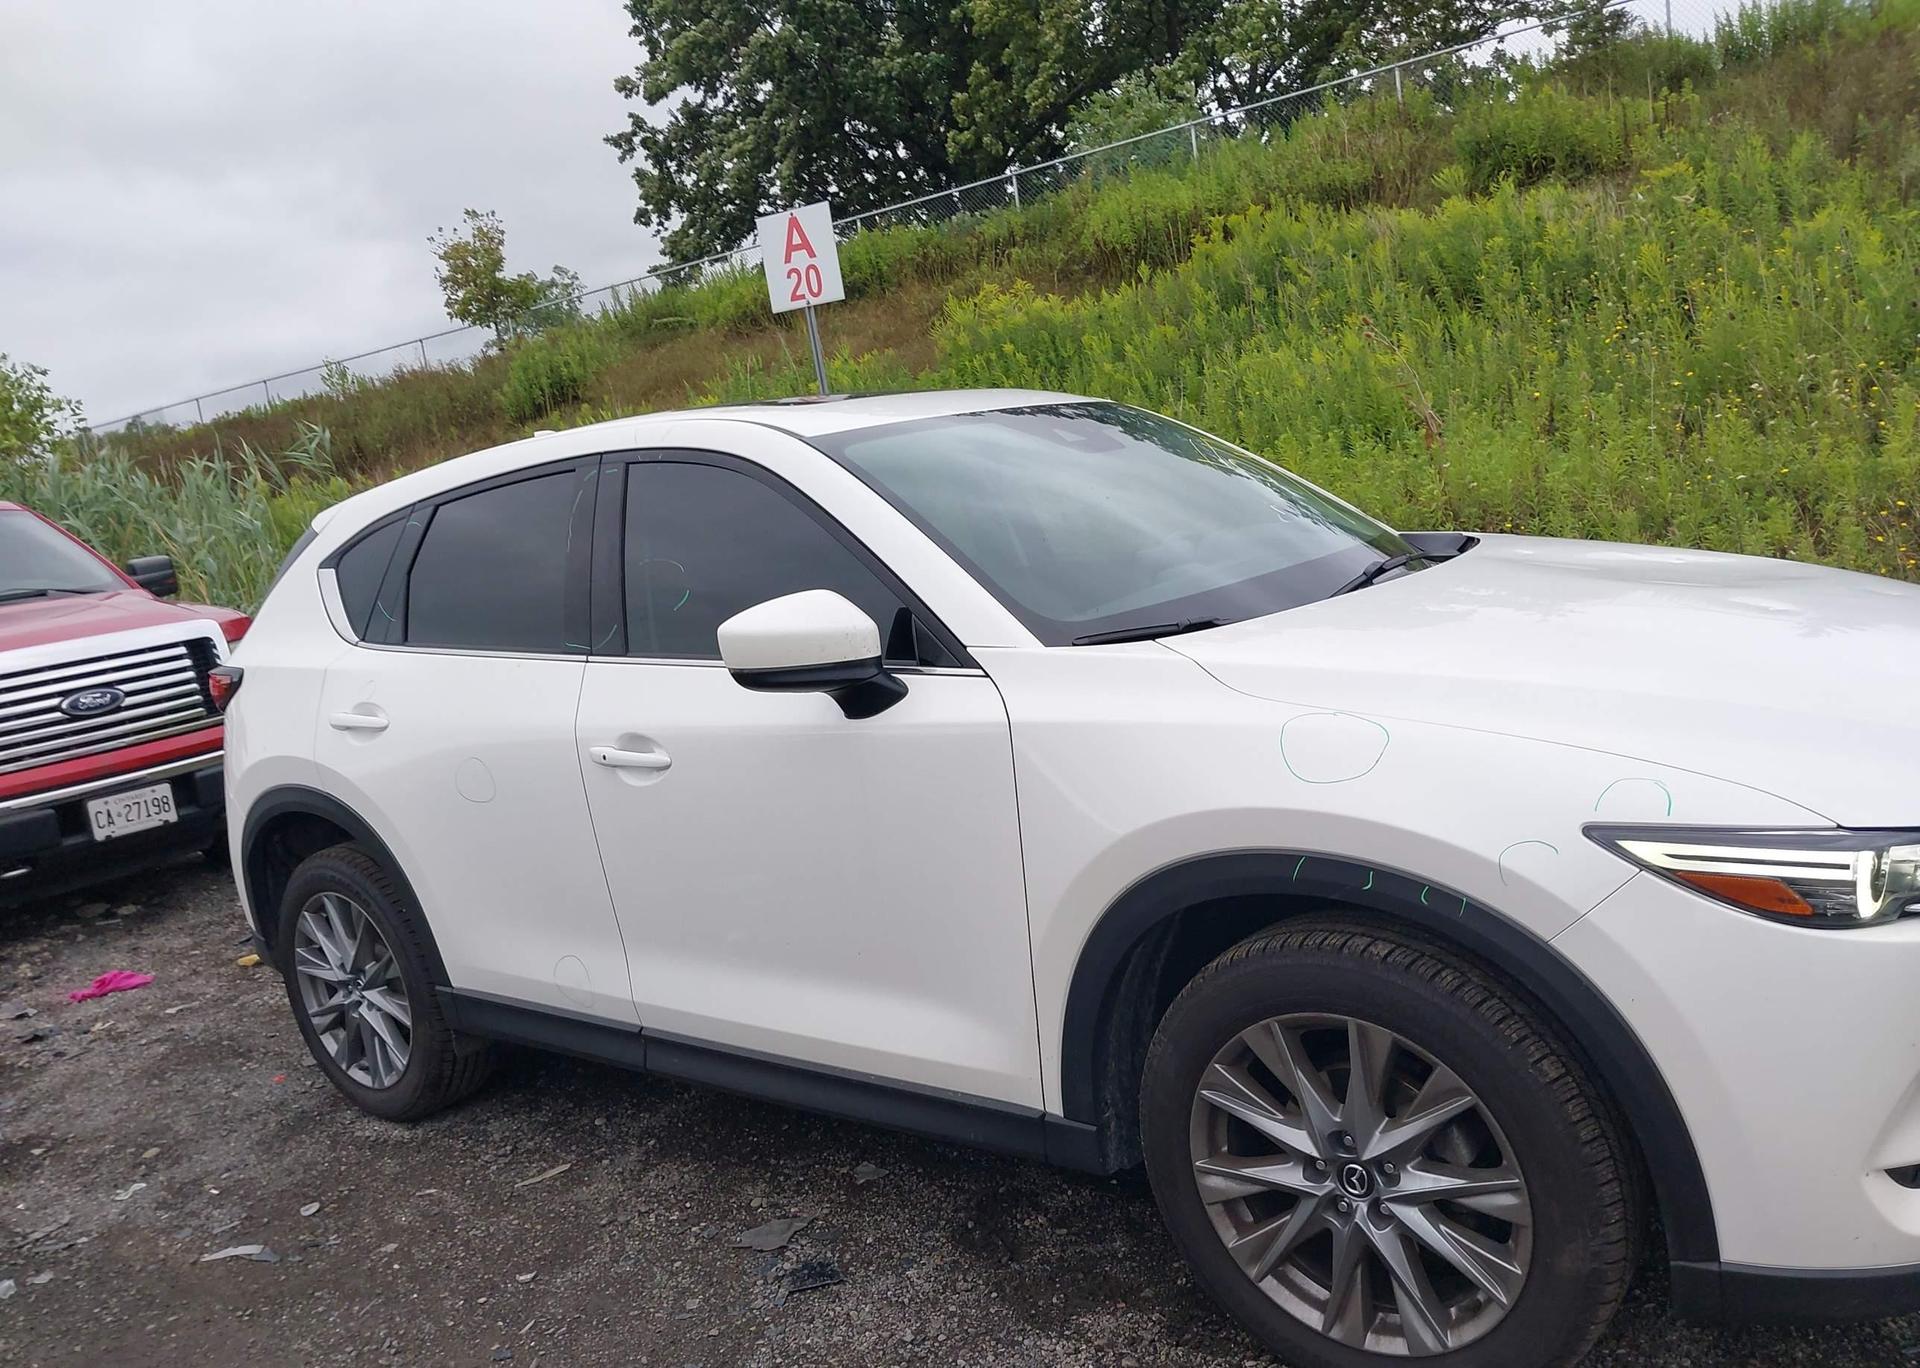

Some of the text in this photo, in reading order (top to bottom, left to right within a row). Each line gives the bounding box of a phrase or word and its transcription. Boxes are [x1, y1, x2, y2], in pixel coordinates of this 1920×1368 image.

[784, 215, 817, 264] A
[786, 264, 823, 302] 20
[79, 693, 111, 709] Ford
[123, 795, 171, 823] 27198
